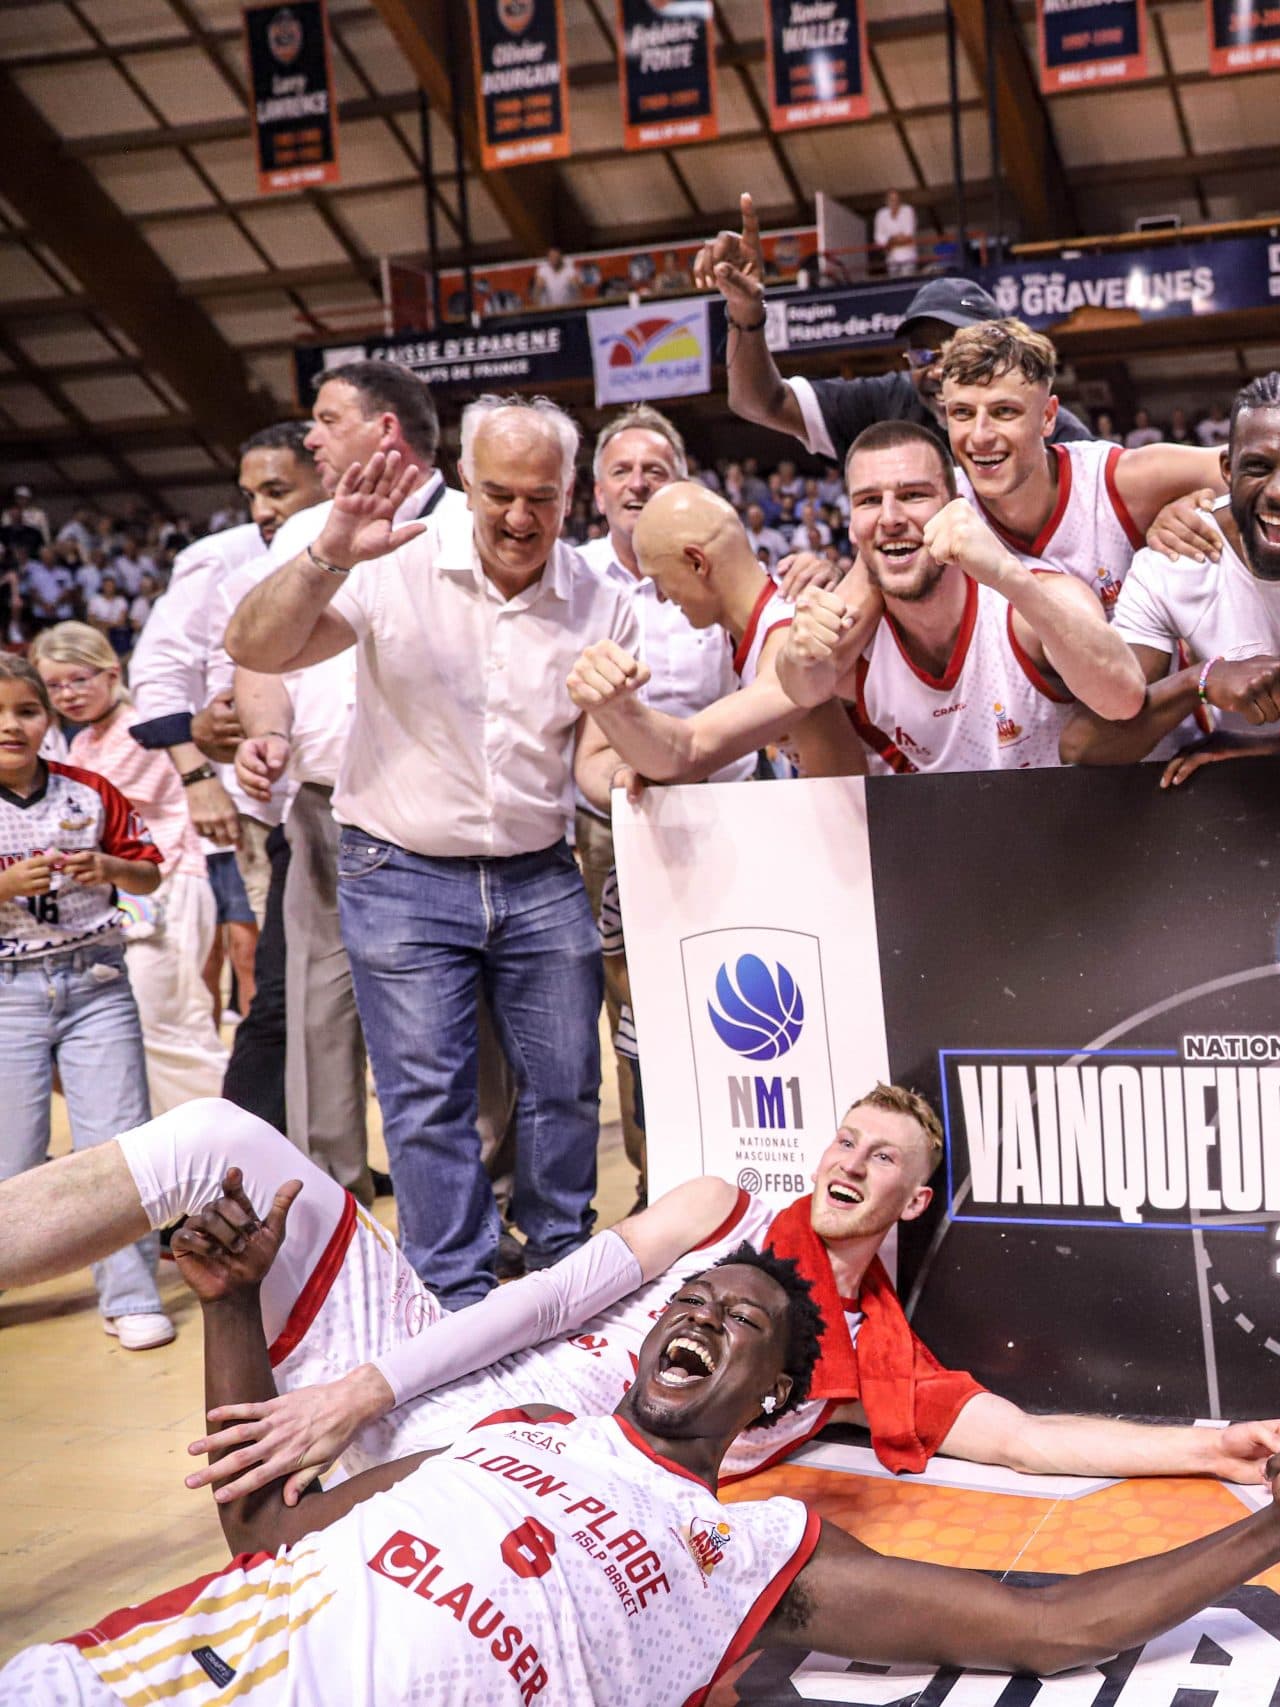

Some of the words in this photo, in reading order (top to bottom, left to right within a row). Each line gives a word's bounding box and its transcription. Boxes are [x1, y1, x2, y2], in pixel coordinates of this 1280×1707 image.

[727, 1075, 804, 1129] NM1
[735, 1150, 796, 1163] MASCULINE
[739, 1137, 799, 1149] NATIONALE
[764, 1174, 805, 1193] FFBB
[454, 1447, 671, 1609] LOON-PLAGE
[571, 1529, 607, 1563] ASLP
[604, 1564, 639, 1618] BASKET
